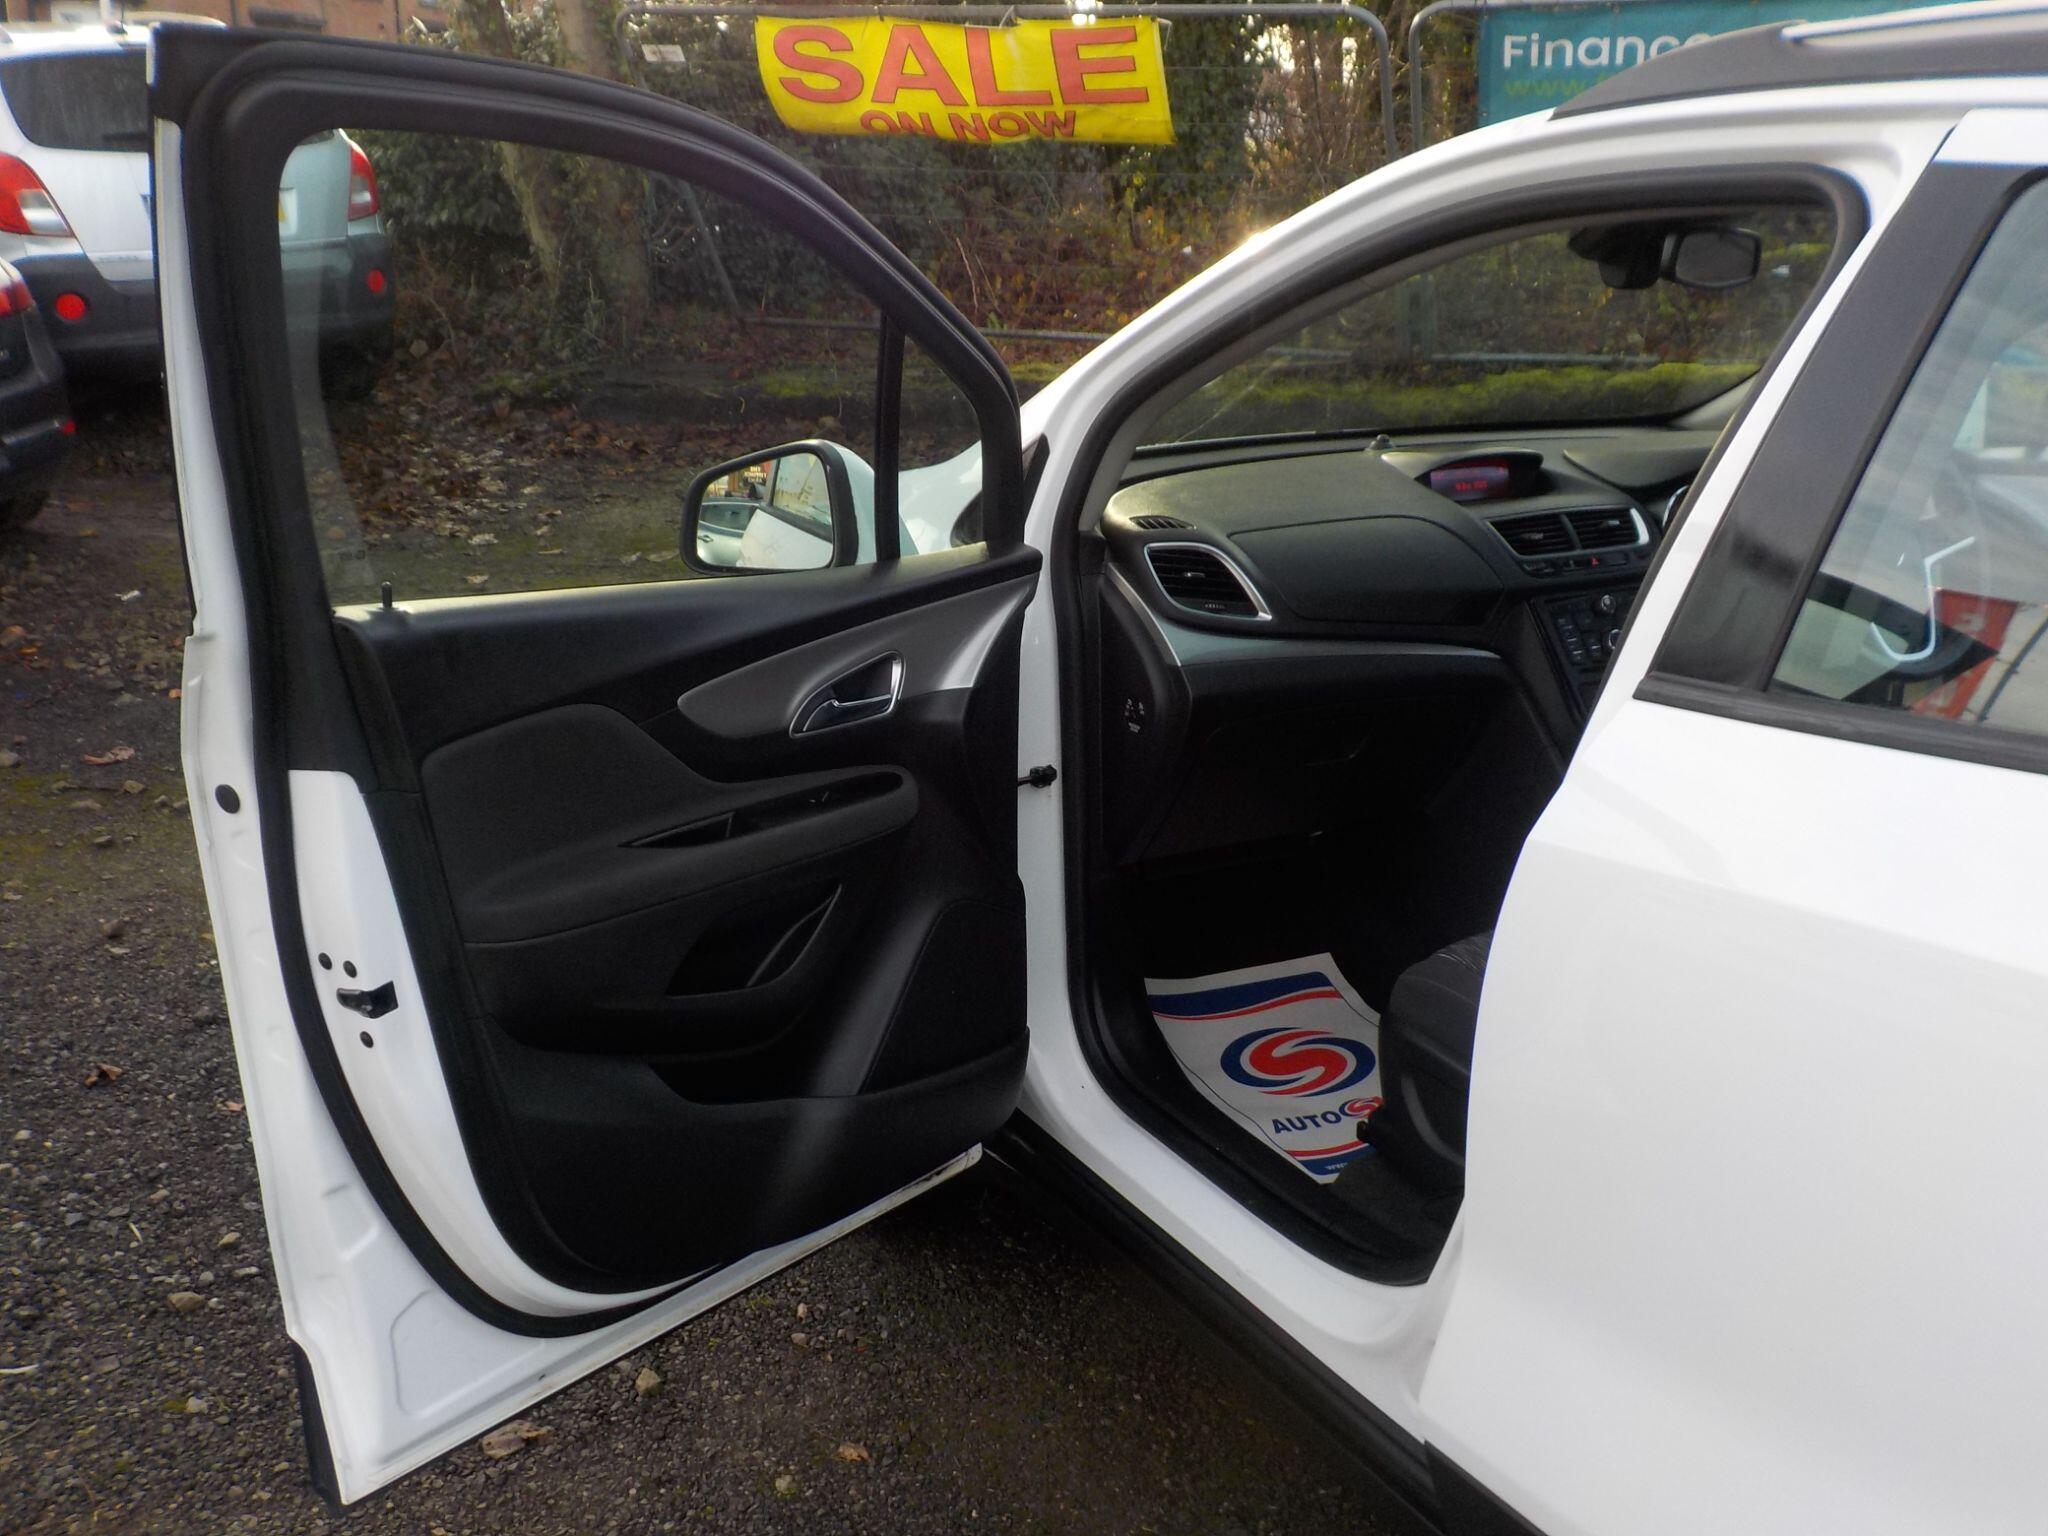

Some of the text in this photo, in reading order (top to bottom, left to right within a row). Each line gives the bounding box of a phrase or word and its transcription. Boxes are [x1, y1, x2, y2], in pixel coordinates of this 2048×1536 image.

[773, 24, 1150, 107] SALE
[1503, 32, 1710, 68] Financ
[859, 110, 1076, 143] ON NOW
